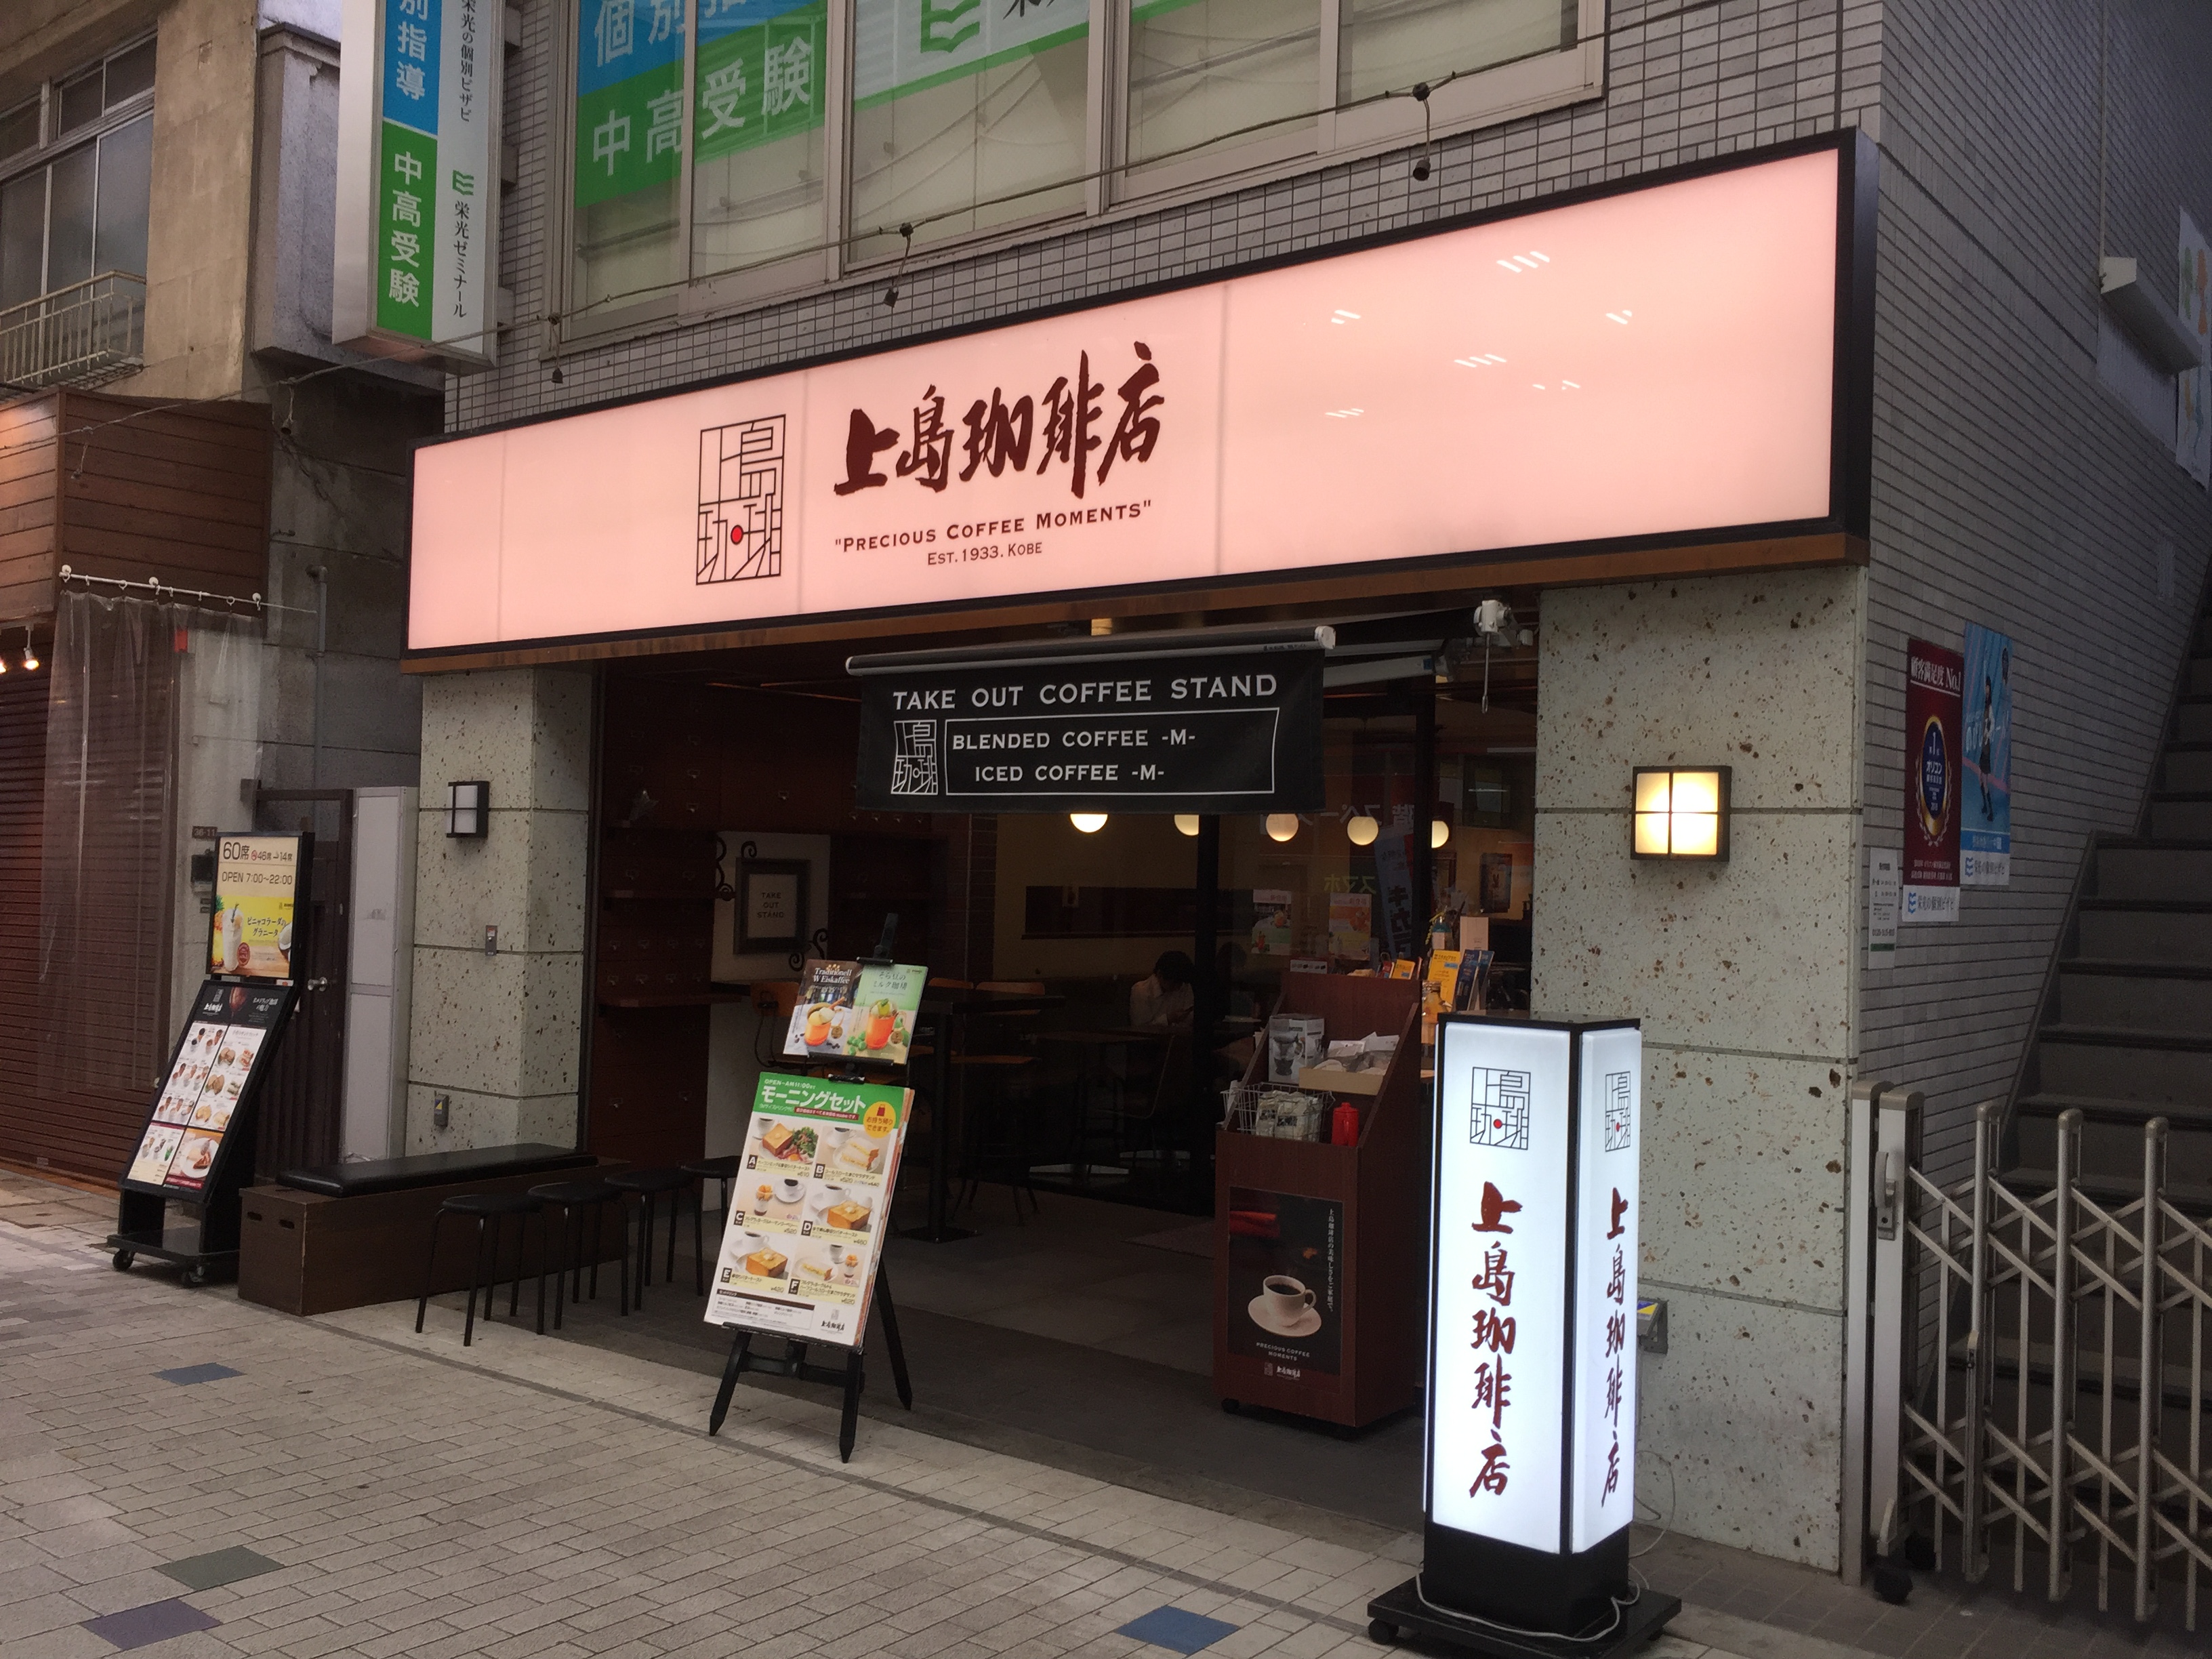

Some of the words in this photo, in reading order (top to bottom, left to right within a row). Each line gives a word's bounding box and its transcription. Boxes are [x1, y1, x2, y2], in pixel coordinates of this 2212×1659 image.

[594, 36, 812, 176] 中高受験
[389, 151, 422, 307] 中高受験
[453, 201, 470, 318] 栄光ゼミナール
[834, 341, 1165, 499] 上島珈琲店
[947, 518, 1025, 539] COFFEE
[1008, 542, 1042, 556] KOBE
[893, 690, 956, 710] TAKE
[971, 686, 1023, 708] OUT
[1040, 680, 1152, 705] COFFEE
[1170, 674, 1277, 699] STAND
[953, 733, 1050, 751] BLENDED
[1062, 730, 1149, 747] COFFEE
[1161, 729, 1195, 745] -M-
[975, 765, 1024, 782] ICED
[1035, 764, 1119, 781] COFFEE
[1131, 765, 1165, 781] -M-
[1926, 760, 1942, 775] オリコン
[222, 842, 250, 860] 60席
[222, 872, 243, 882] OPEN
[815, 967, 853, 977] Traditionell
[821, 975, 851, 984] Eiskaffee
[762, 1085, 866, 1113] モーニングセット
[748, 1156, 756, 1165] A
[816, 1165, 823, 1174] B
[736, 1212, 744, 1221] C
[803, 1223, 812, 1231] D
[723, 1269, 731, 1278] E
[791, 1280, 800, 1290] F
[1469, 1181, 1523, 1498] 上島珈琲店
[1601, 1187, 1629, 1508] 上島珈琲店
